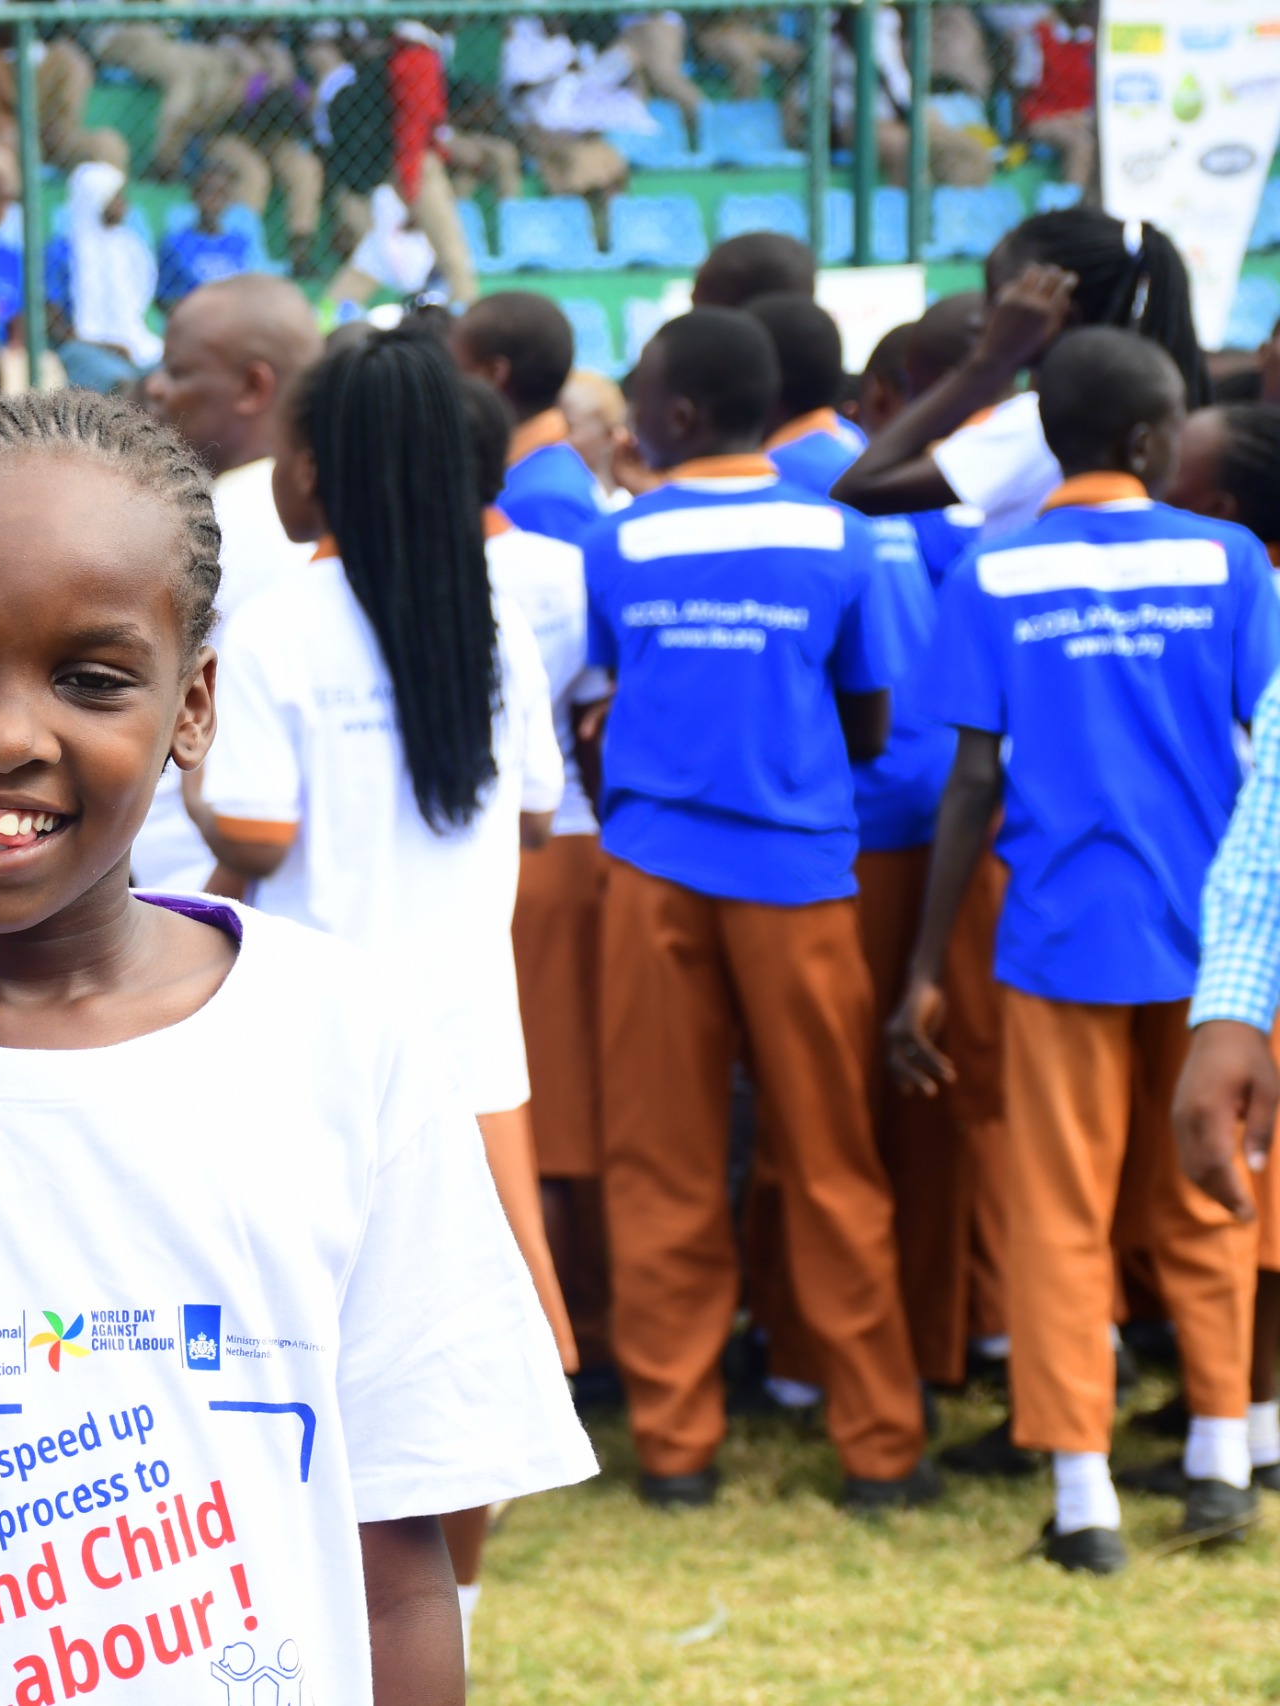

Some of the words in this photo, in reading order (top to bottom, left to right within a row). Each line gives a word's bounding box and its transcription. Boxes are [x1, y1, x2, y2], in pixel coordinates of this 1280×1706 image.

[90, 1309, 130, 1324] WORLD
[133, 1308, 156, 1323] DAY
[91, 1323, 139, 1338] AGAINST
[225, 1334, 260, 1348] Ministry
[91, 1337, 125, 1352] CHILD
[128, 1337, 175, 1351] LABOUR
[109, 1404, 154, 1445] up
[134, 1459, 170, 1493] to
[81, 1479, 236, 1590] Child
[229, 1563, 258, 1632] !
